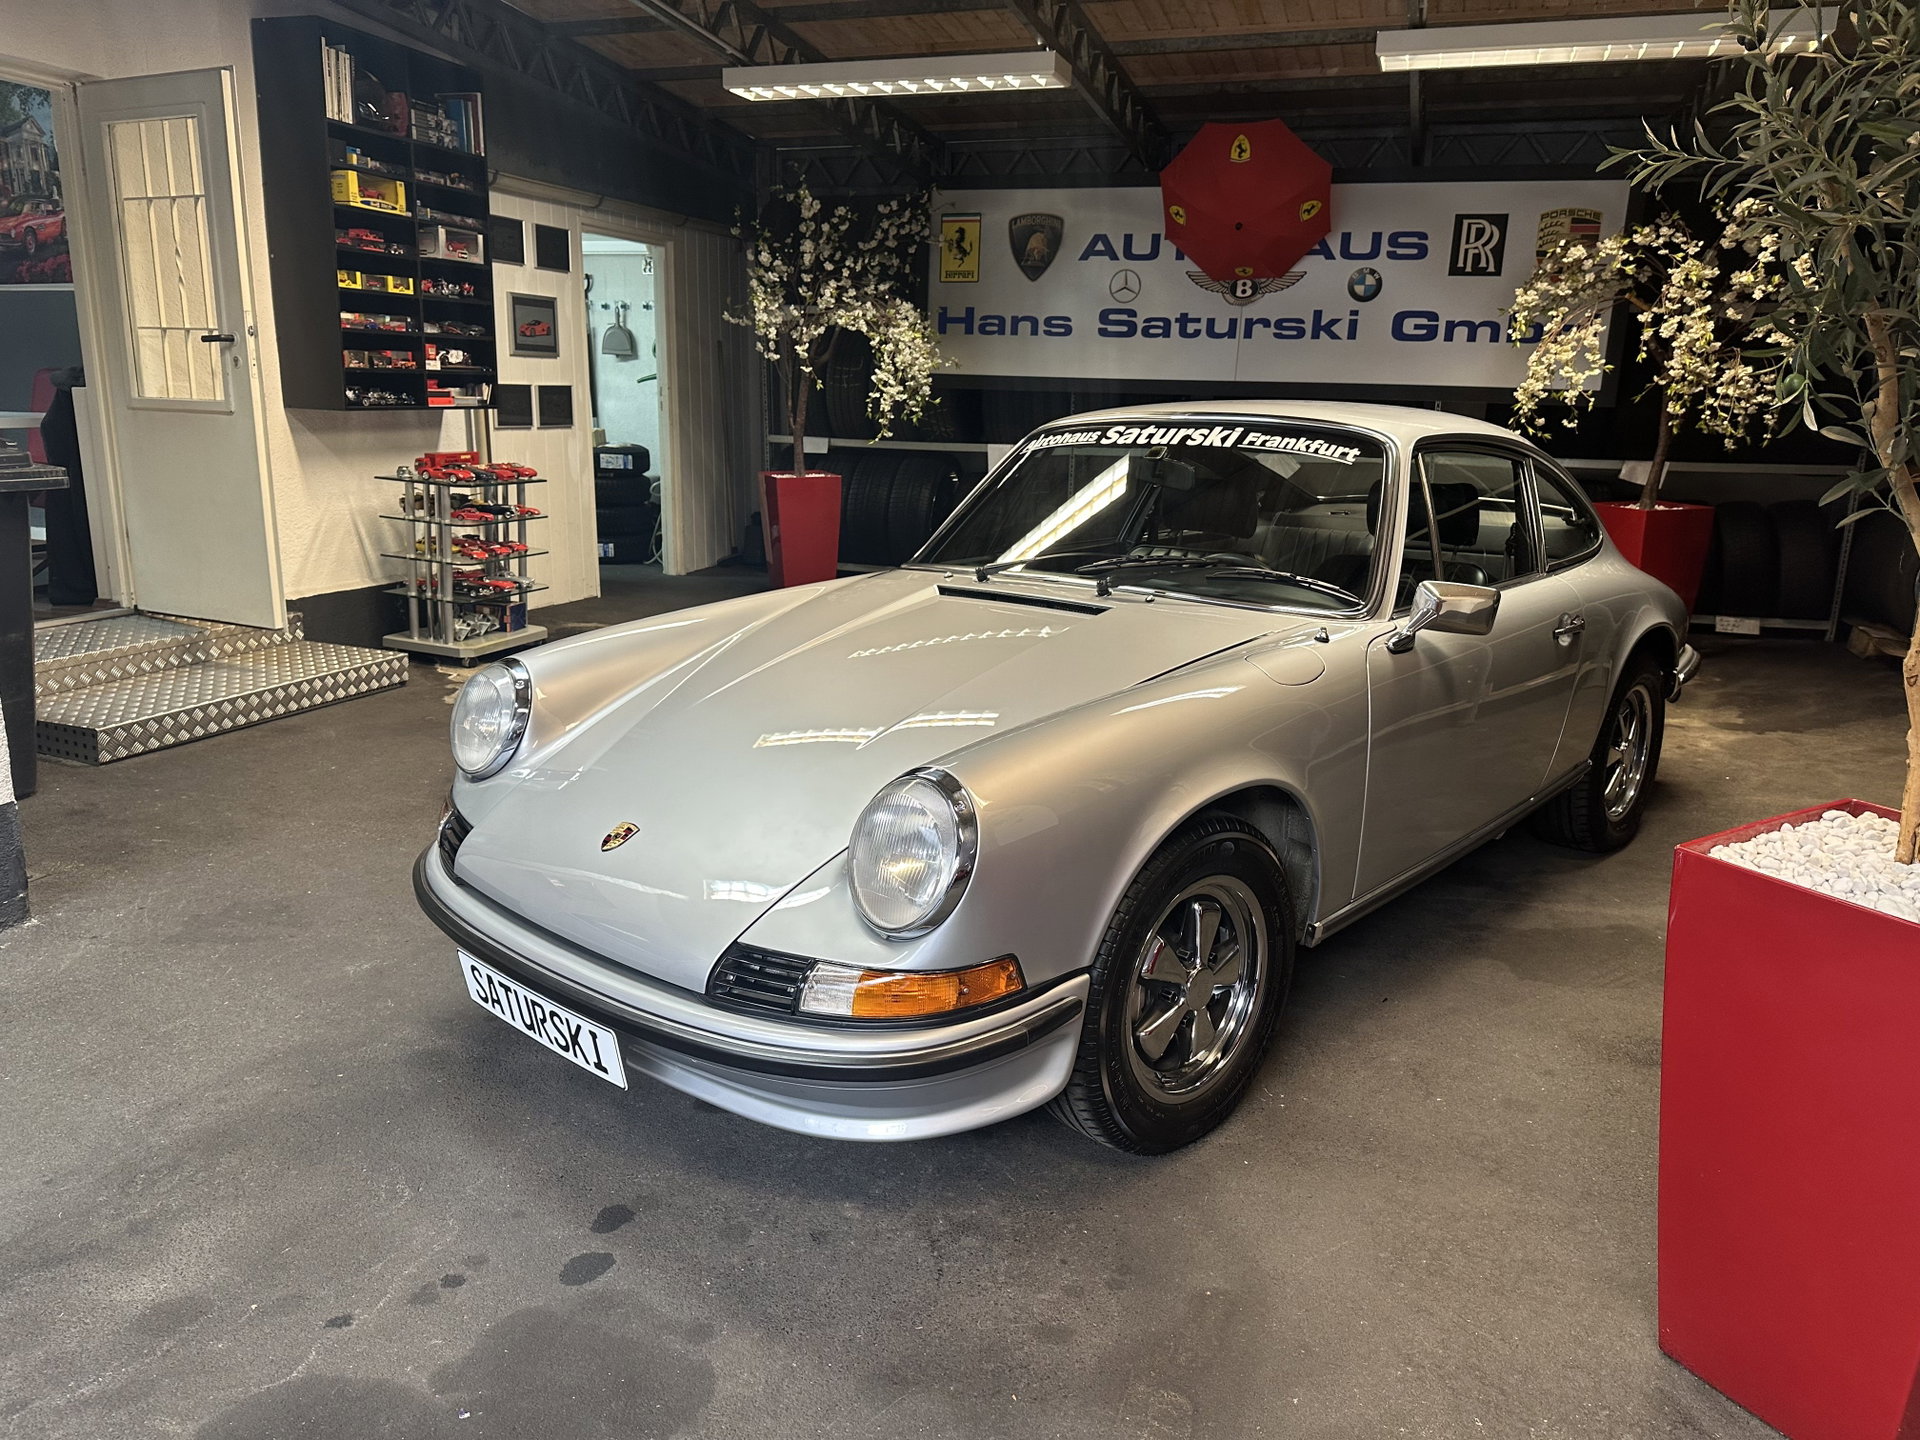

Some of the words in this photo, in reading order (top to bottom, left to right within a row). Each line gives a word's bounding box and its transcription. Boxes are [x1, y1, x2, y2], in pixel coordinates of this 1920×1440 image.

[1541, 208, 1602, 222] PORSCHE
[1352, 267, 1381, 280] BMW
[937, 306, 1073, 337] Hans
[1097, 308, 1360, 341] Saturski
[1100, 425, 1245, 448] Saturski
[1242, 432, 1362, 462] Frankfurt
[470, 964, 609, 1075] SATURSKI
